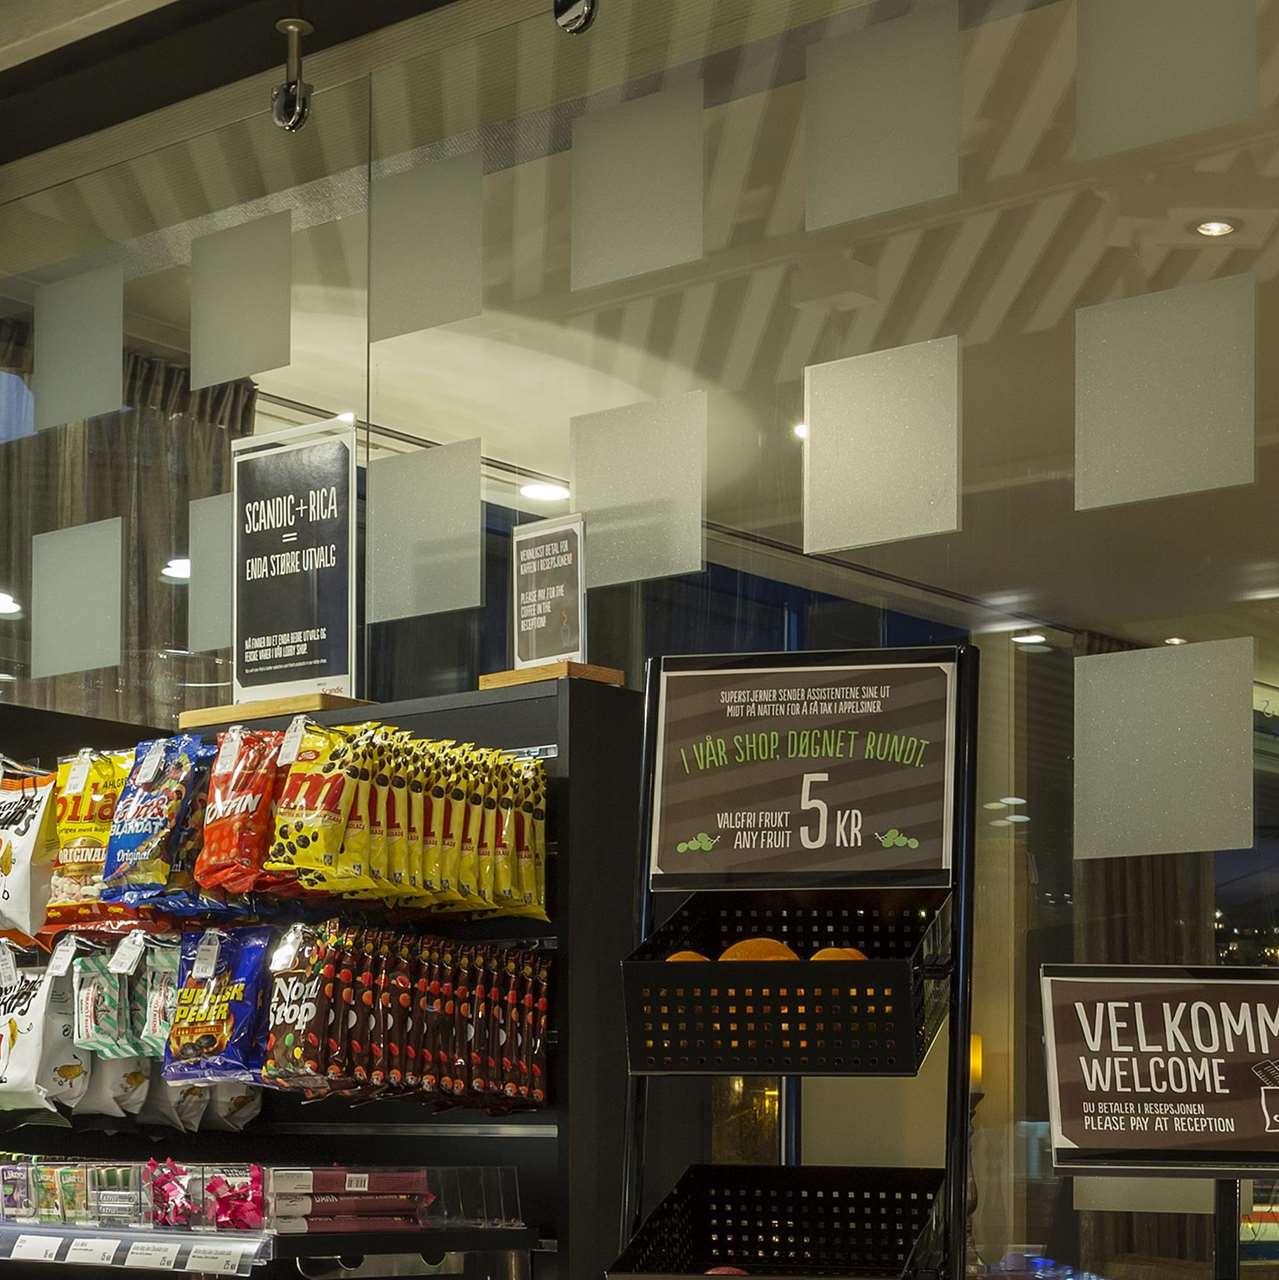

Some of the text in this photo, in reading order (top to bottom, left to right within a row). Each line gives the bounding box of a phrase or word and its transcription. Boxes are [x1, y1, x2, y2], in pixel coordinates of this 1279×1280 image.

[246, 544, 336, 581] ENDA STØRRE UTVALG
[720, 685, 890, 703] SUPERSTJERNER SENDER ASSISTENTENE SINE UT
[746, 703, 756, 716] PÅ
[757, 703, 785, 716] NATTEN
[787, 703, 800, 716] FOR
[801, 701, 808, 715] Å
[809, 701, 818, 715] FÅ
[819, 702, 832, 714] TAK
[680, 748, 690, 774] I
[692, 735, 728, 770] VÅR
[787, 729, 859, 759] DØGNET
[864, 731, 930, 768] RUNDT.
[716, 810, 791, 829] VALGFRI FRUKT
[799, 772, 862, 849] 5 KR
[734, 831, 792, 849] ANY FRUIT
[117, 849, 152, 865] Original
[1079, 1056, 1230, 1094] WELCOME
[1083, 1102, 1095, 1113] DU
[1098, 1102, 1135, 1114] BETALER
[1144, 1103, 1205, 1116] RESEPSJONEN
[1084, 1115, 1235, 1133] PLEASE PAY AT RECEPTION
